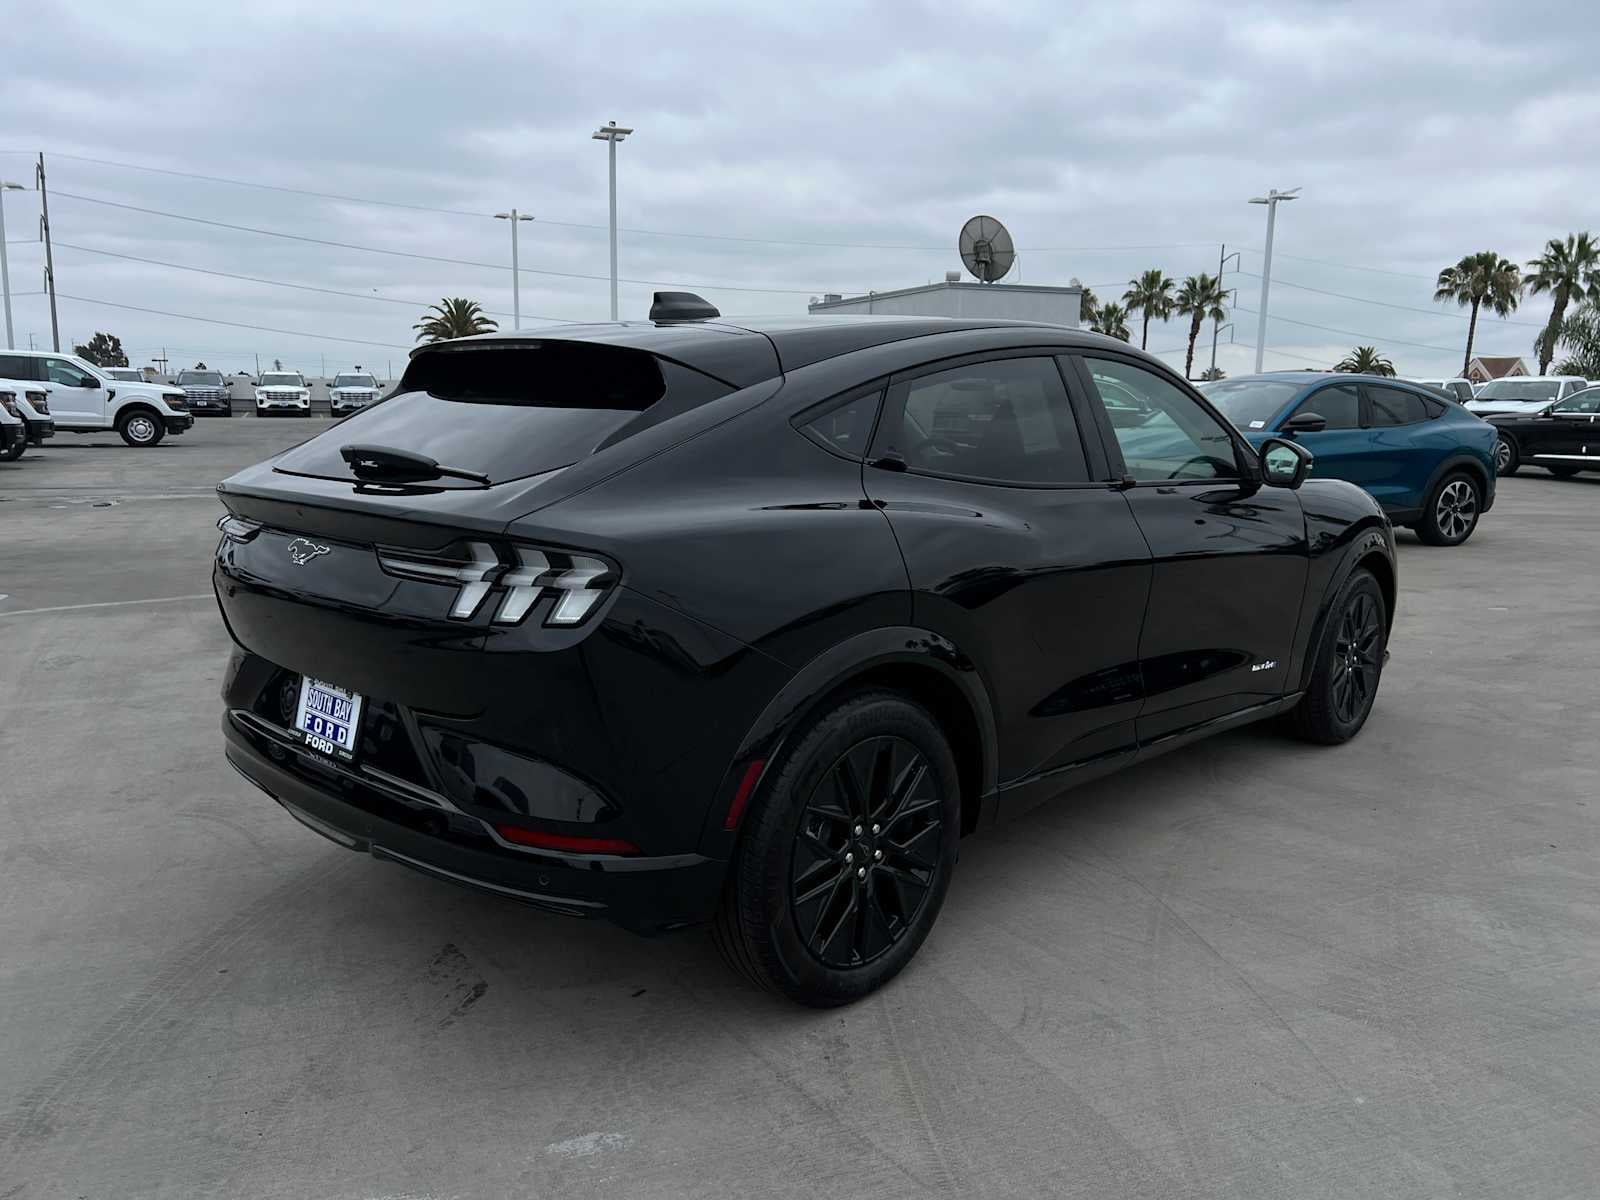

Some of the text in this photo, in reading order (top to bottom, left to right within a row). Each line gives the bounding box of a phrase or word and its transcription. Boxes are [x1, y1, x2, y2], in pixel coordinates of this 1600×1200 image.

[308, 688, 333, 715] SOUTH
[334, 699, 352, 721] BAY
[304, 713, 347, 744] FORD
[304, 733, 334, 755] FORD
